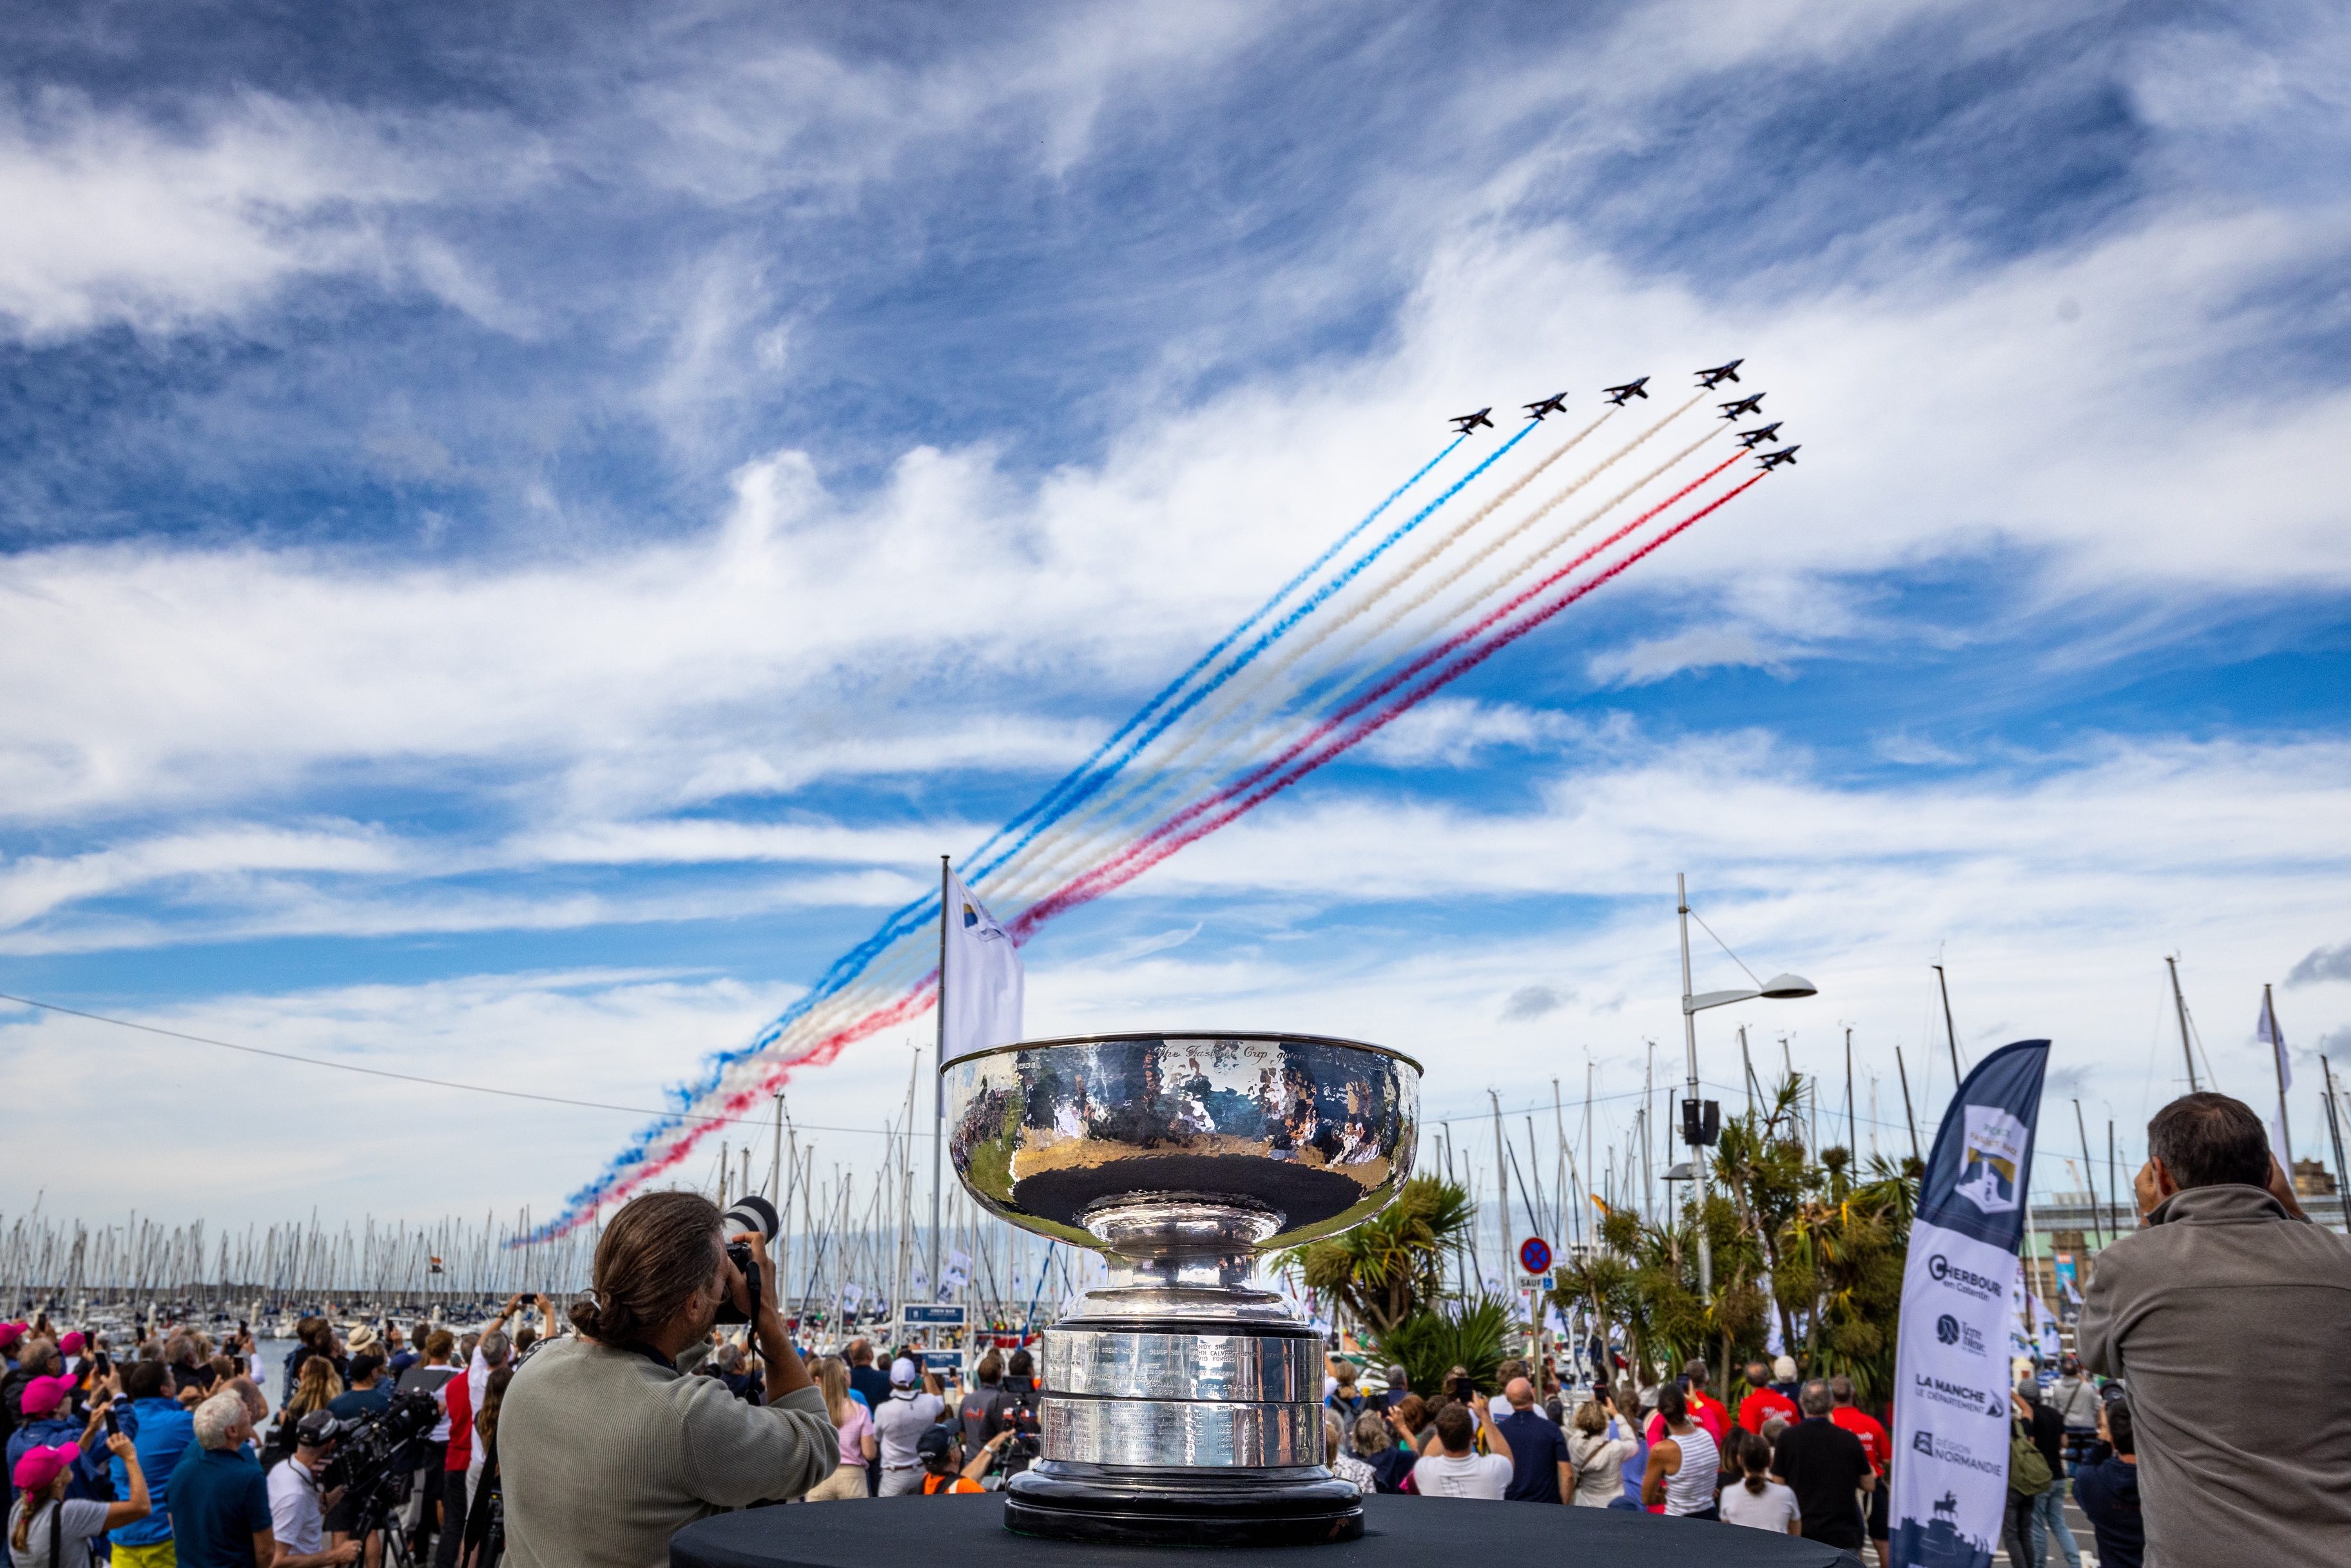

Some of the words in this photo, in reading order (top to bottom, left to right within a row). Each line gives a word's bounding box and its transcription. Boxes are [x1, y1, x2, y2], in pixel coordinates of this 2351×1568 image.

[1520, 1279, 1542, 1288] SAUF
[1915, 1374, 1932, 1387] LA
[1935, 1379, 1986, 1403] MANCHE
[1935, 1449, 2002, 1477] NORMANDIE
